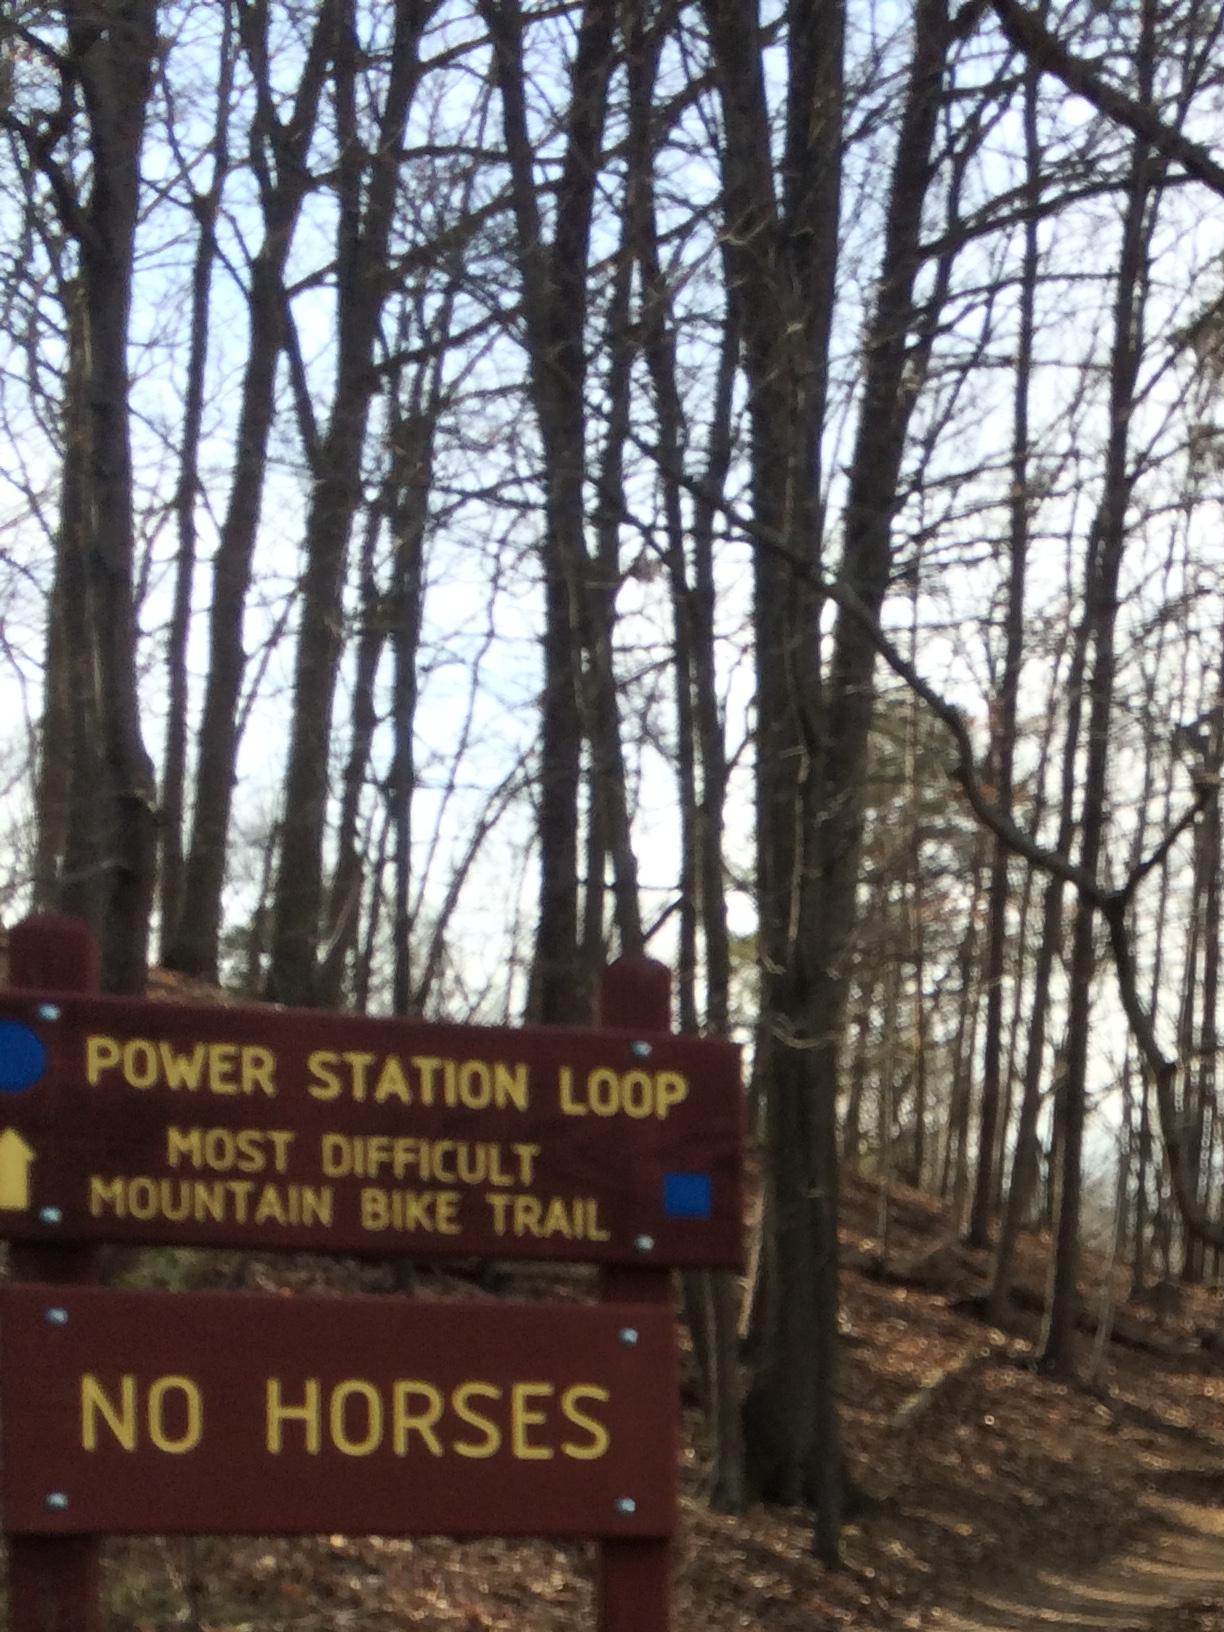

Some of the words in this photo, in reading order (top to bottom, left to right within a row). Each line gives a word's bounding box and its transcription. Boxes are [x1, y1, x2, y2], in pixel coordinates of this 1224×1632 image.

[86, 1035, 276, 1095] POWER
[308, 1050, 529, 1111] STATION
[559, 1067, 690, 1119] LOOP
[167, 1126, 294, 1173] MOST
[322, 1133, 540, 1185] DIFFICULT
[89, 1176, 332, 1227] MOUNTAIN
[360, 1190, 462, 1235] BIKE
[488, 1194, 611, 1242] TRAIL
[81, 1374, 203, 1455] NO
[266, 1377, 611, 1460] HORSES
